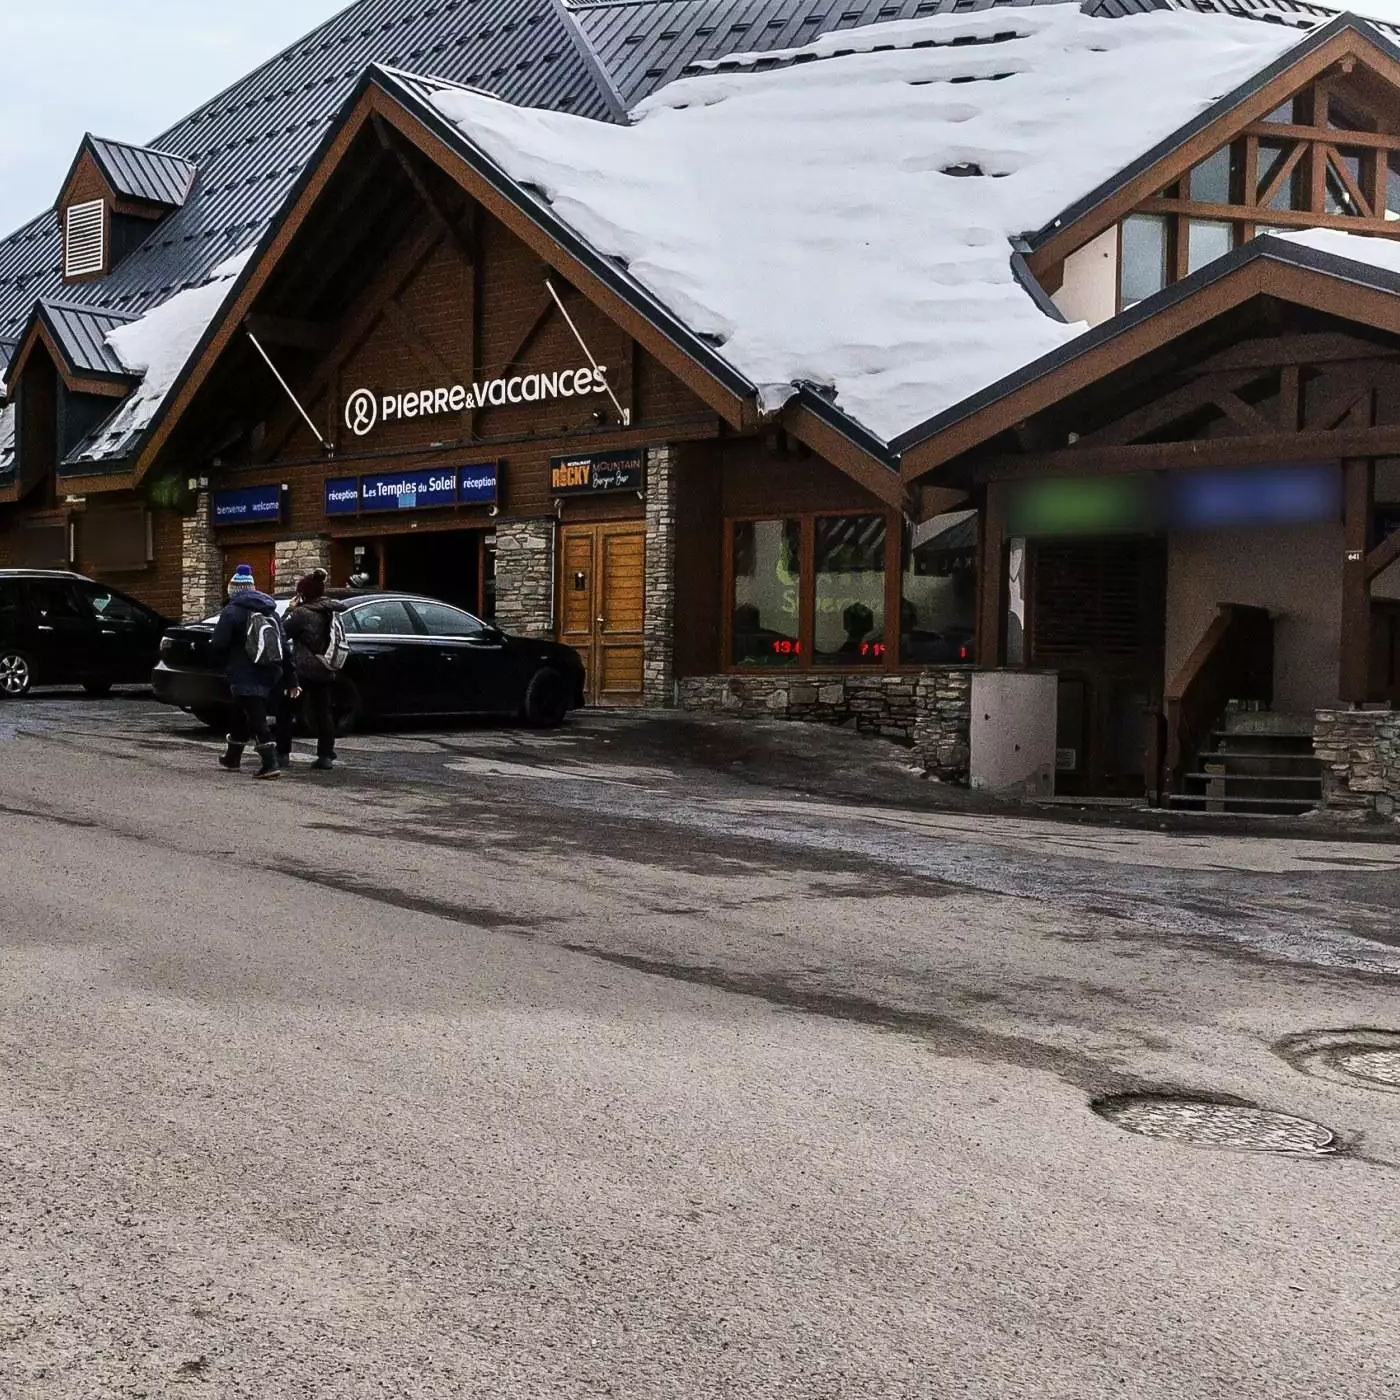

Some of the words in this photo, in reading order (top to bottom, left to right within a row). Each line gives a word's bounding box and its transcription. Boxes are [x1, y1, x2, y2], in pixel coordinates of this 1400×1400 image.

[592, 460, 640, 472] MOUNTAIN
[363, 485, 377, 498] Les
[376, 480, 417, 498] Temples
[418, 483, 428, 493] du
[429, 476, 456, 492] Soleil
[463, 476, 497, 489] réception
[328, 489, 358, 502] réception
